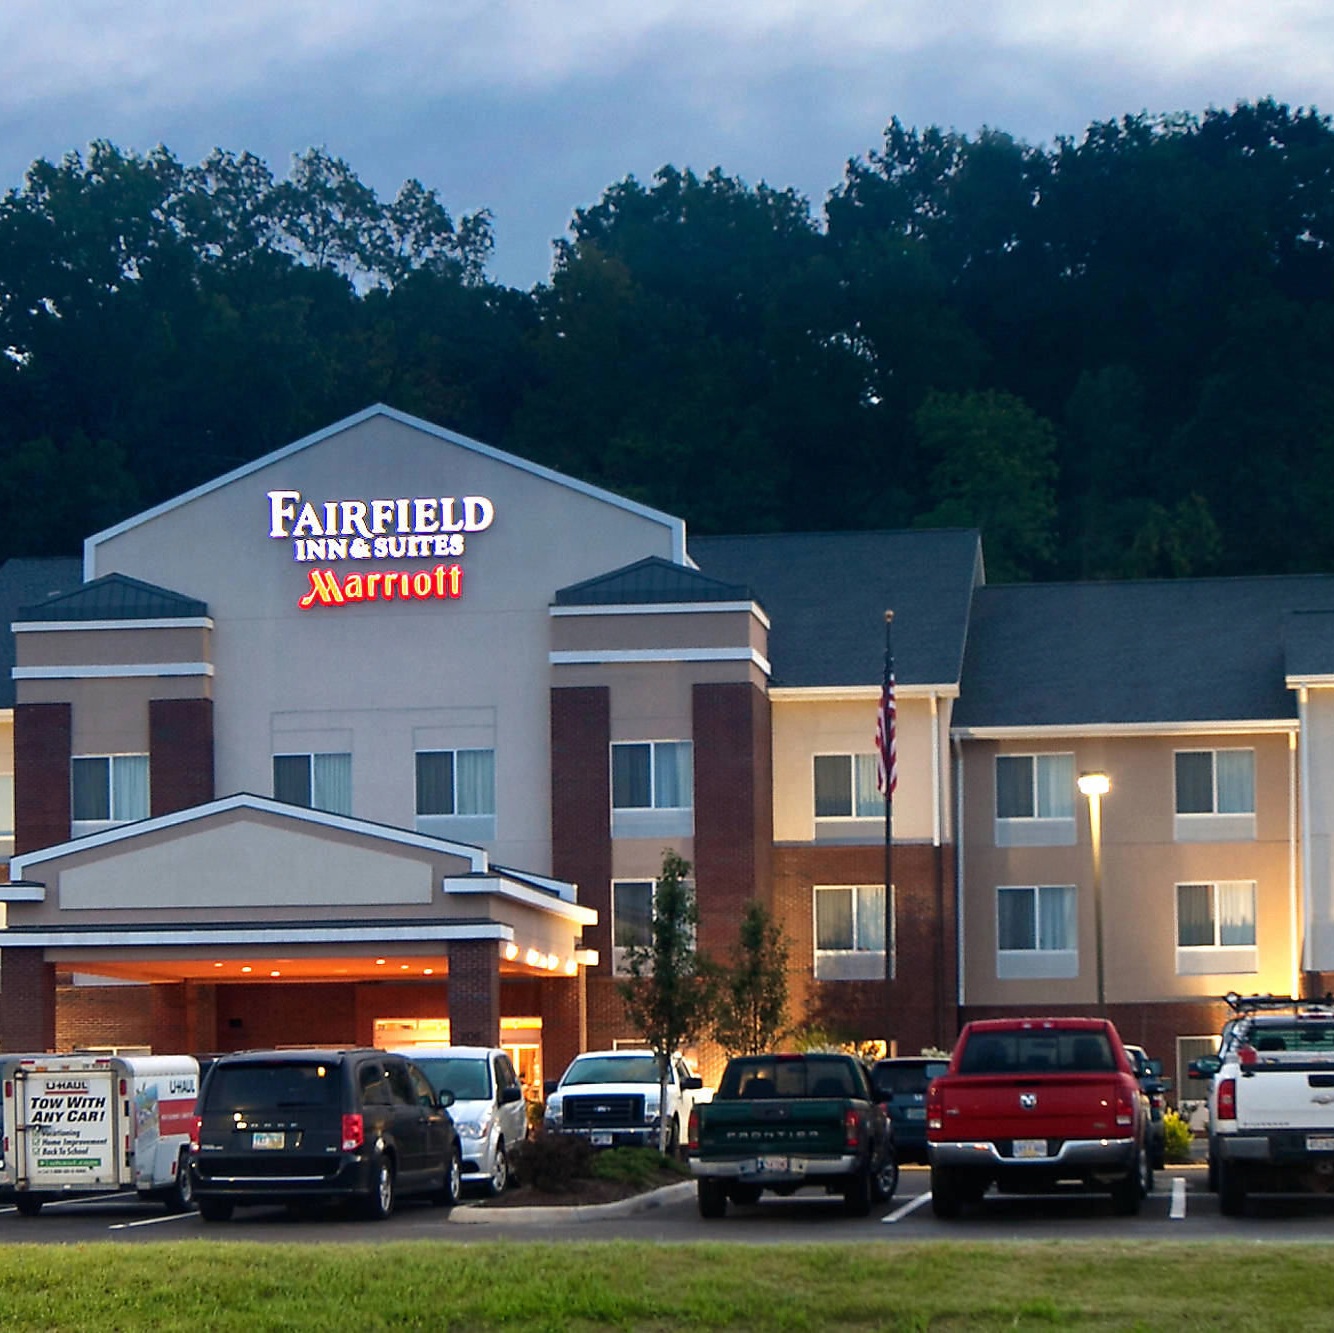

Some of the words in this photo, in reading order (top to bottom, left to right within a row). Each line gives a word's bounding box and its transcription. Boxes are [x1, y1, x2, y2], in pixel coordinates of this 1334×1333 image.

[267, 490, 494, 539] FAIRFIELD
[298, 564, 463, 609] Marriott
[46, 1082, 88, 1090] U-HAUL
[31, 1097, 64, 1109] TOW
[67, 1096, 106, 1108] WITH
[31, 1111, 64, 1123] ANY
[67, 1110, 105, 1122] CAR!
